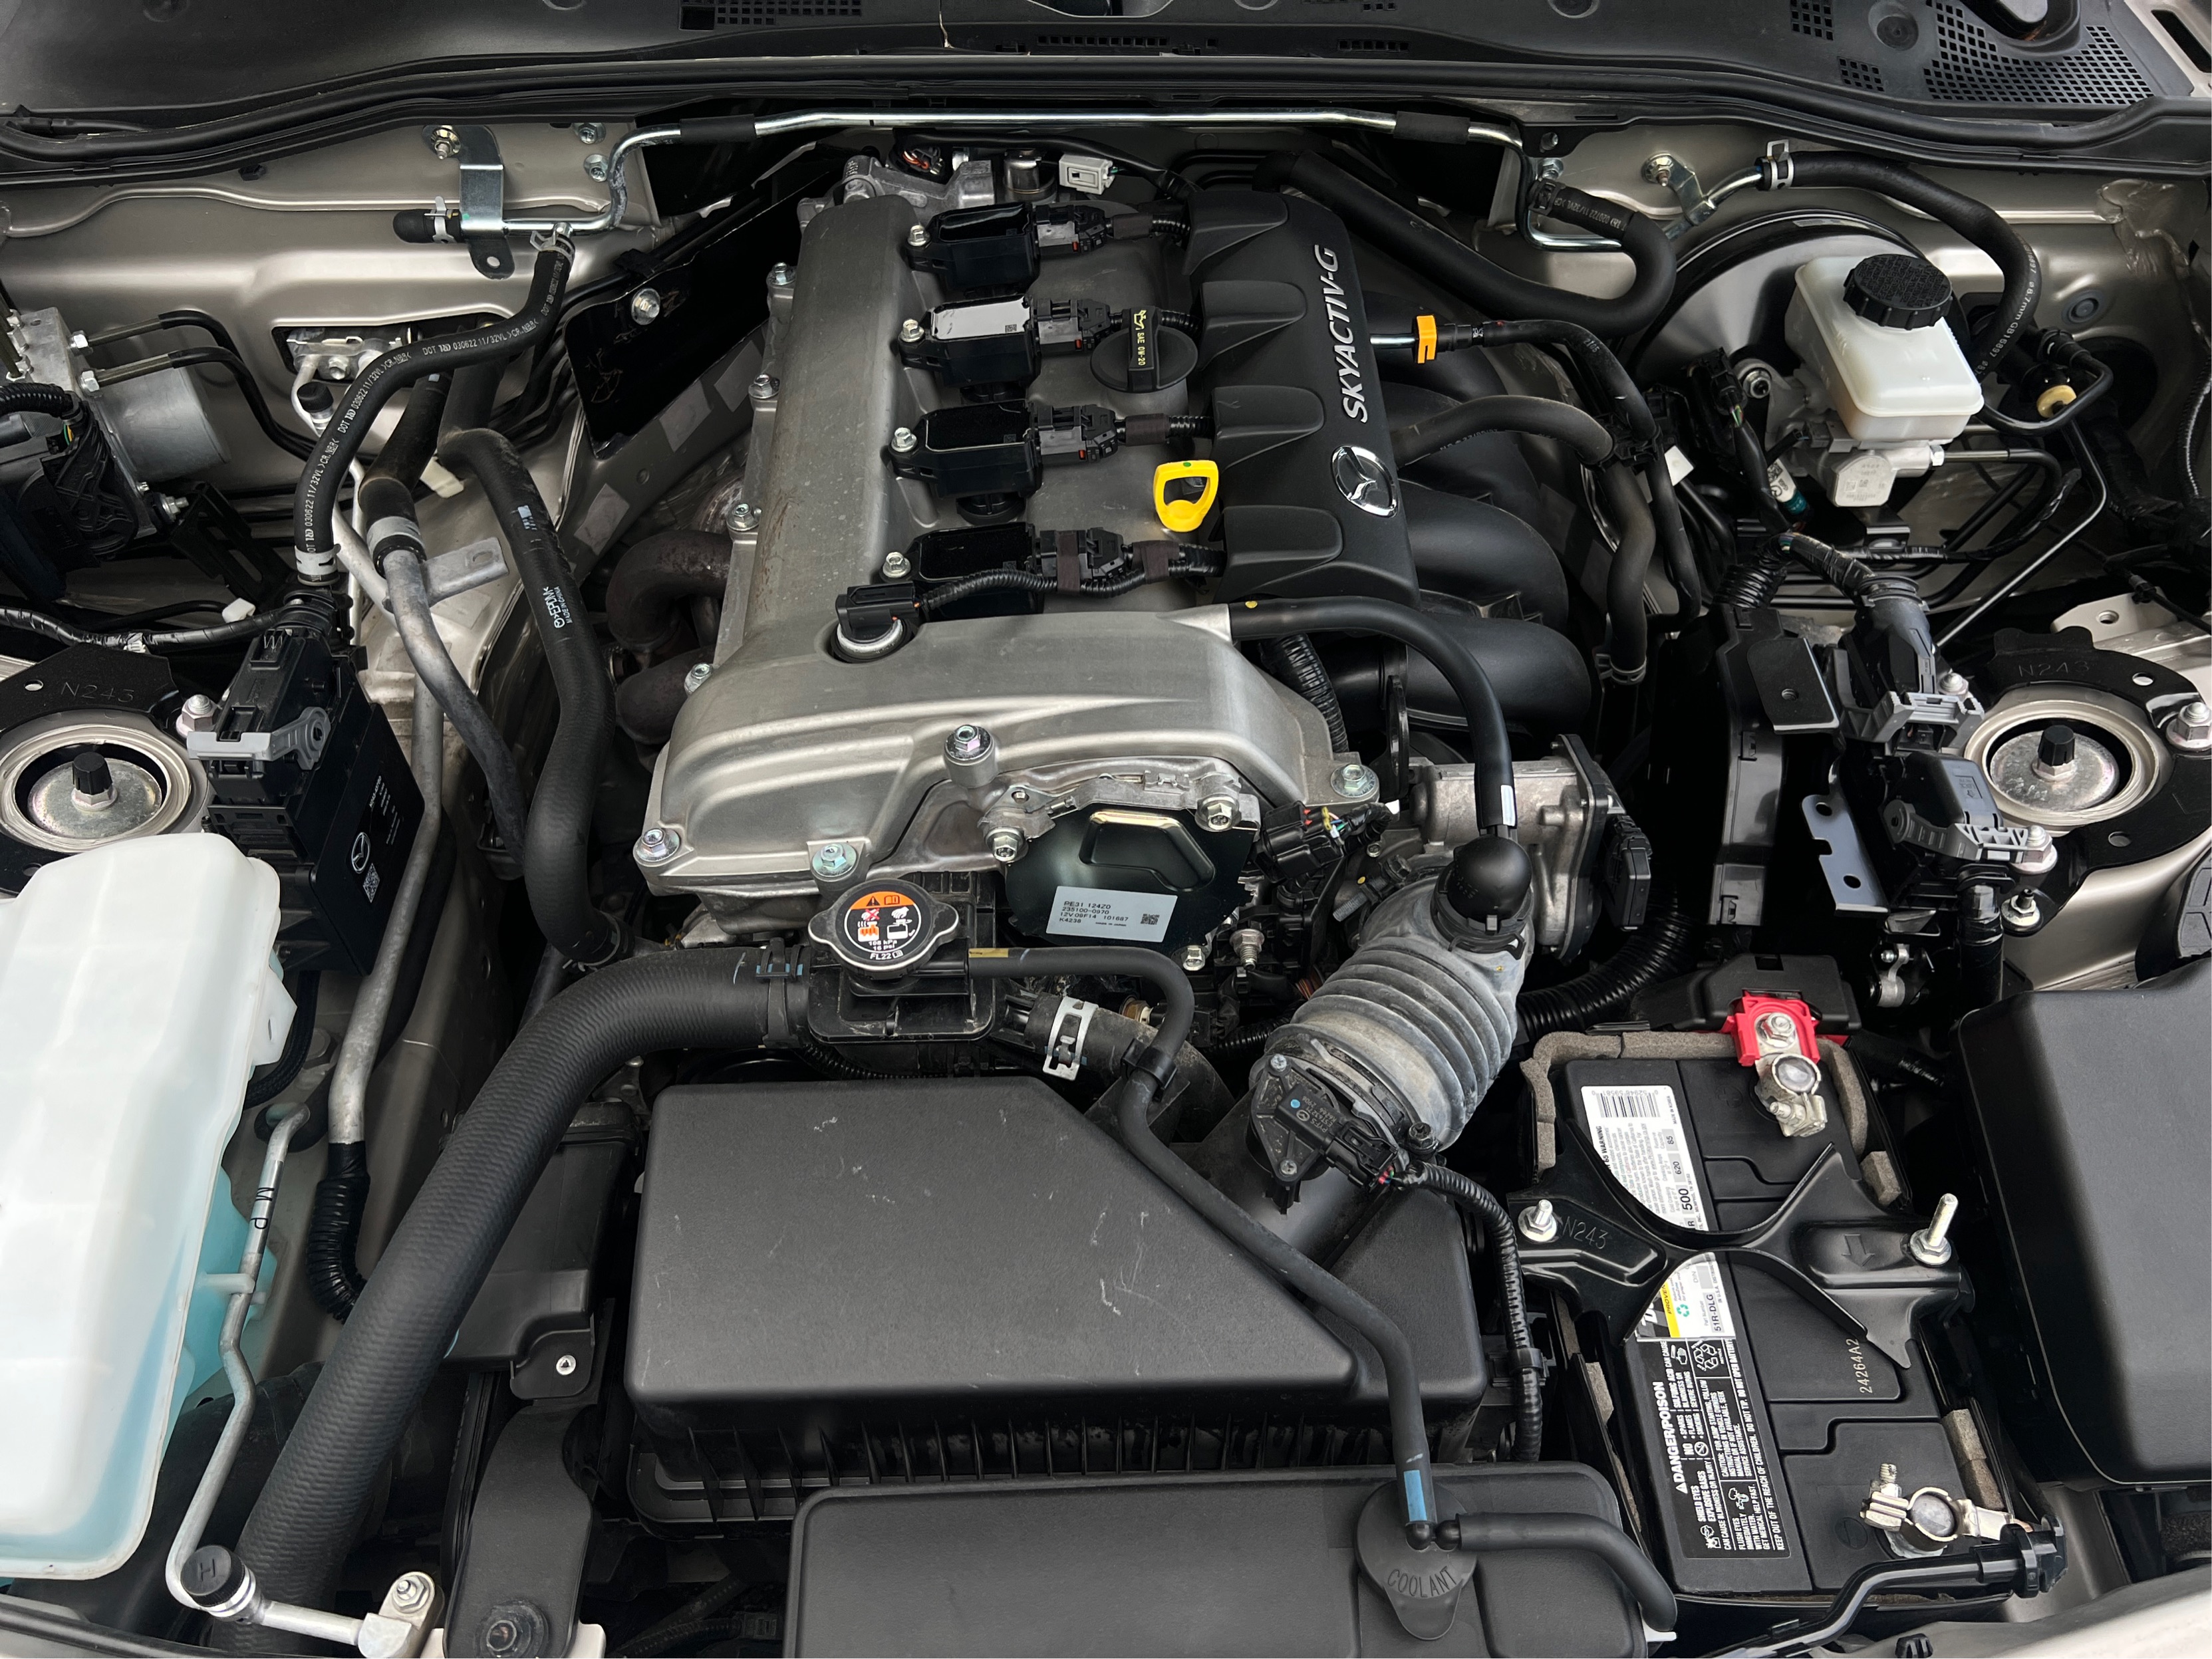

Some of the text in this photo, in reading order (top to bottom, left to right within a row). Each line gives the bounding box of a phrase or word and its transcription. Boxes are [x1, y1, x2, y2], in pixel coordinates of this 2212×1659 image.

[1589, 209, 1610, 224] 020722
[1315, 244, 1367, 423] SKYACTIV-G
[1989, 322, 2018, 357] GB16897
[422, 346, 436, 356] DOT
[453, 339, 478, 350] 030622
[337, 420, 350, 433] DOT
[351, 388, 368, 409] 030622
[305, 469, 324, 527] 030622 11/32VL
[554, 586, 565, 601] CHINA
[562, 606, 573, 623] MADE
[1310, 1118, 1329, 1132] PYFS
[1597, 1126, 1607, 1153] WARNING
[1679, 1189, 1692, 1210] 500
[1562, 1216, 1609, 1249] N243
[1706, 1294, 1721, 1331] 51R-DLG
[1659, 1340, 1669, 1356] CAUSE
[1666, 1368, 1675, 1380] ACID
[1731, 1364, 1741, 1377] OPEN
[1846, 1339, 1873, 1393] 24264A2
[1677, 1380, 1689, 1408] BLINDNESS
[1684, 1372, 1697, 1407] SEVERE BURNS
[1700, 1380, 1710, 1399] FOLLOW
[1734, 1378, 1744, 1388] NOT
[1669, 1382, 1681, 1408] SULFURIC
[1711, 1392, 1721, 1412] OWNERS
[1717, 1391, 1726, 1402] SEEK
[1740, 1400, 1749, 1409] TIP.
[1705, 1400, 1717, 1424] STARTING,
[1721, 1404, 1732, 1430] AVAILABLE,
[1742, 1410, 1752, 1422] NOT
[1653, 1382, 1684, 1481] DANGER/POISON
[1677, 1415, 1687, 1435] SPARKS
[1685, 1415, 1695, 1434] FLAMES
[1693, 1413, 1704, 1435] SMOKING
[1711, 1426, 1720, 1440] JUMP
[1715, 1414, 1726, 1433] VEHICLE
[1683, 1444, 1694, 1455] NO
[1723, 1441, 1736, 1476] INSTRUCTIONS
[1733, 1424, 1752, 1476] SERVICE ASSISTANCE.
[1750, 1434, 1763, 1465] CHILDREN.
[1705, 1461, 1715, 1480] INJURY
[1718, 1453, 1728, 1477] CAUTION:
[1734, 1454, 1744, 1476] MANUAL
[1697, 1471, 1716, 1521] EXPLOSIVE GASES
[1760, 1475, 1771, 1495] REACH
[1691, 1485, 1706, 1521] SHIELD EYES
[1711, 1489, 1724, 1519] BLINDNESS
[1764, 1497, 1774, 1508] THE
[1748, 1484, 1770, 1549] GET MEDICAL HELP FAST.
[1770, 1521, 1780, 1533] OUT
[1719, 1520, 1728, 1537] CAUSE
[1732, 1518, 1746, 1549] FLUSH EYES
[1740, 1513, 1754, 1549] IMMEDIATELY
[1748, 1514, 1762, 1549] WITH WATER.
[1723, 1539, 1731, 1549] CAN
[1774, 1534, 1784, 1550] KEEP
[201, 1558, 215, 1582] H
[1387, 1565, 1456, 1598] COOLANT
